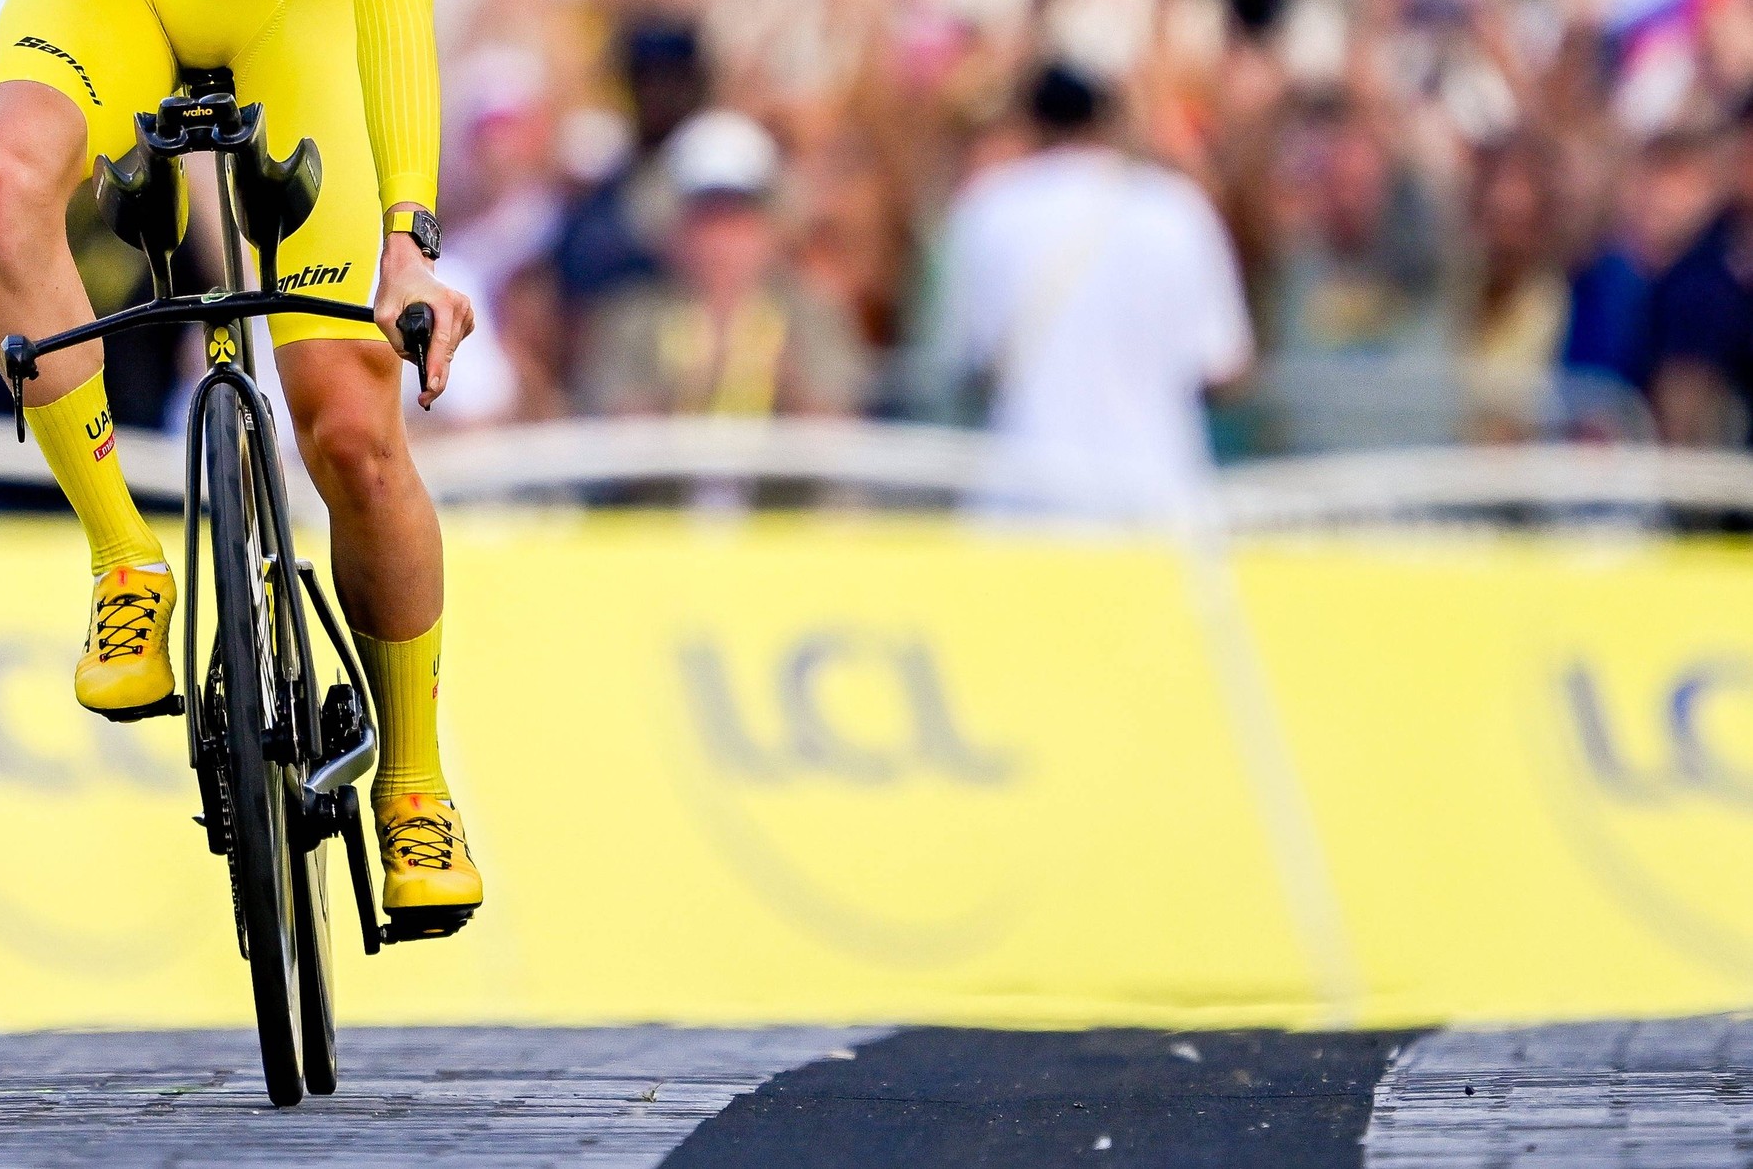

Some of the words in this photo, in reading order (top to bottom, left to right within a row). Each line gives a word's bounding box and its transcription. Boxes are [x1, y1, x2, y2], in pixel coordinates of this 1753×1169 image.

[13, 36, 103, 107] Santini
[278, 262, 352, 293] antini
[676, 621, 1026, 786] LCL
